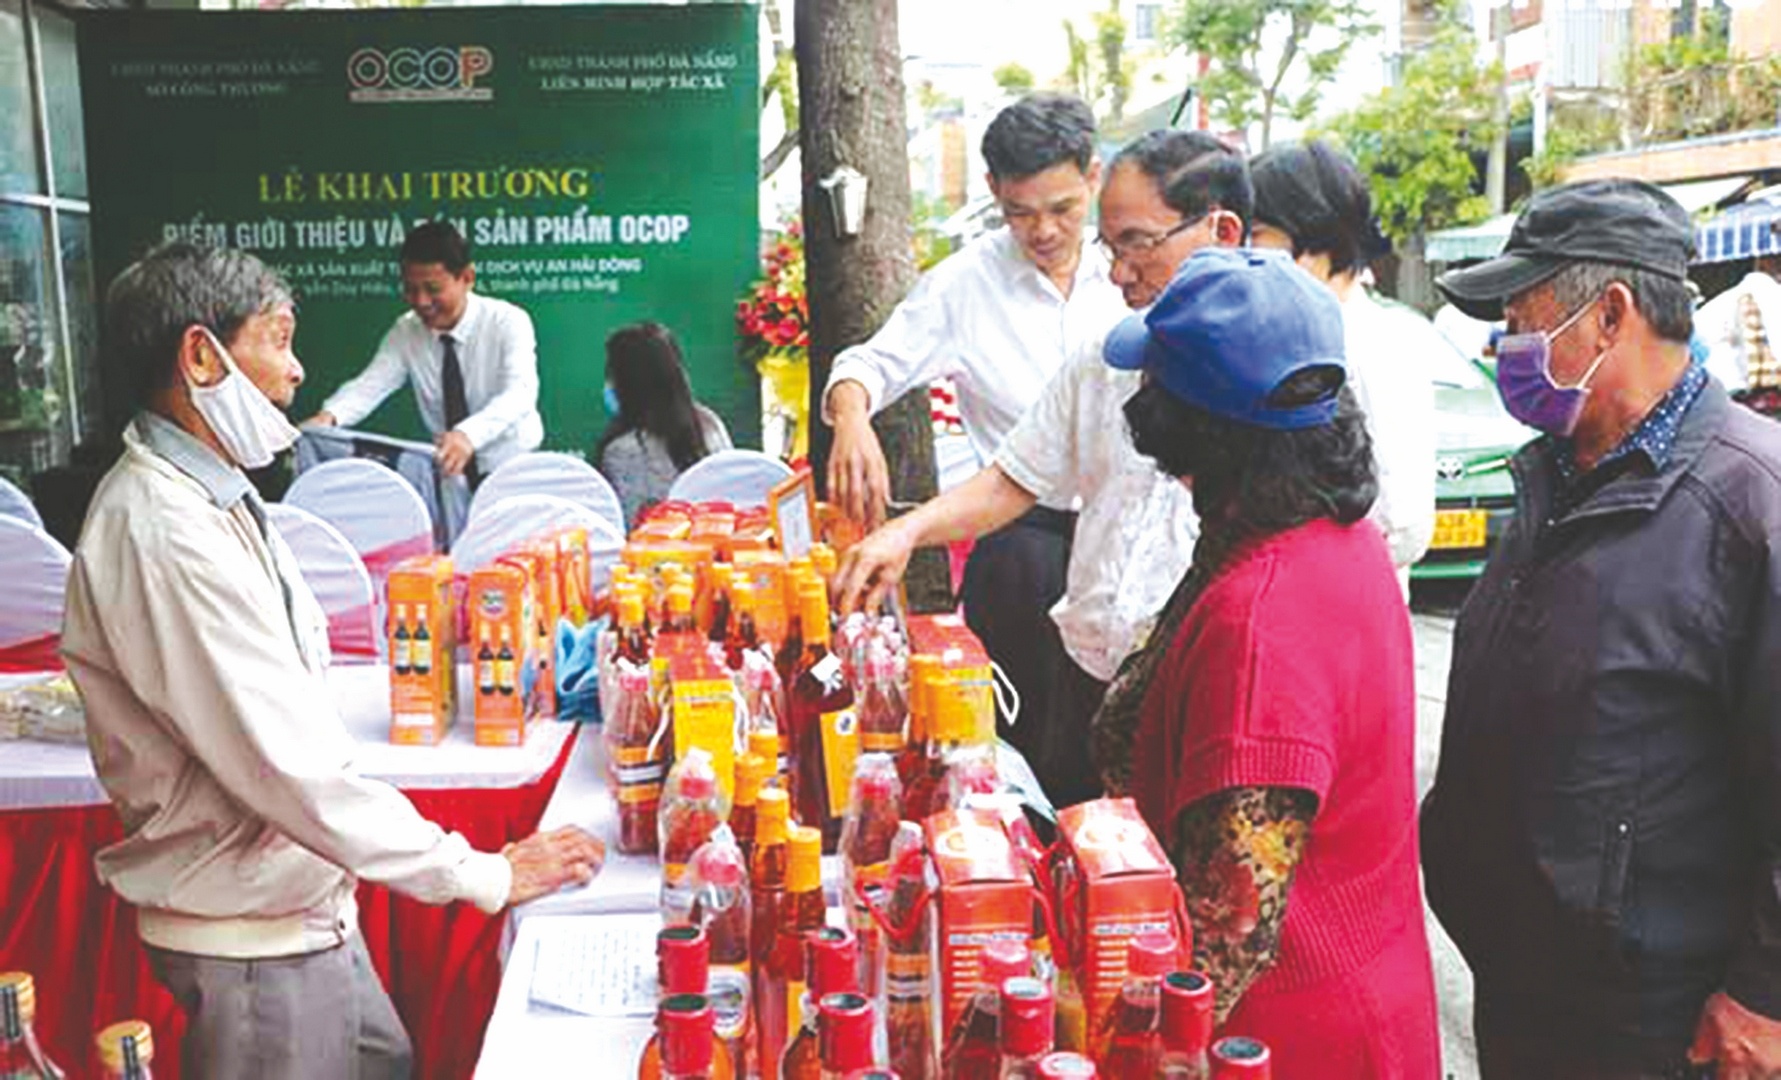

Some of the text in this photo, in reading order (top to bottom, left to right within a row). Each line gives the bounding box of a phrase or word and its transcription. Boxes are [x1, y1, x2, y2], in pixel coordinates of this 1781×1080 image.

[347, 46, 493, 88] OCOP
[318, 171, 412, 202] KHAI
[422, 165, 589, 201] TRƯƠNG
[235, 217, 286, 249] GIỚI
[293, 214, 366, 254] THIỆU
[372, 212, 405, 247] VÀ
[474, 207, 529, 246] SẢN
[535, 205, 612, 245] PHẨM
[619, 214, 690, 244] OCOP
[523, 260, 544, 275] VỤ
[547, 259, 568, 274] AN
